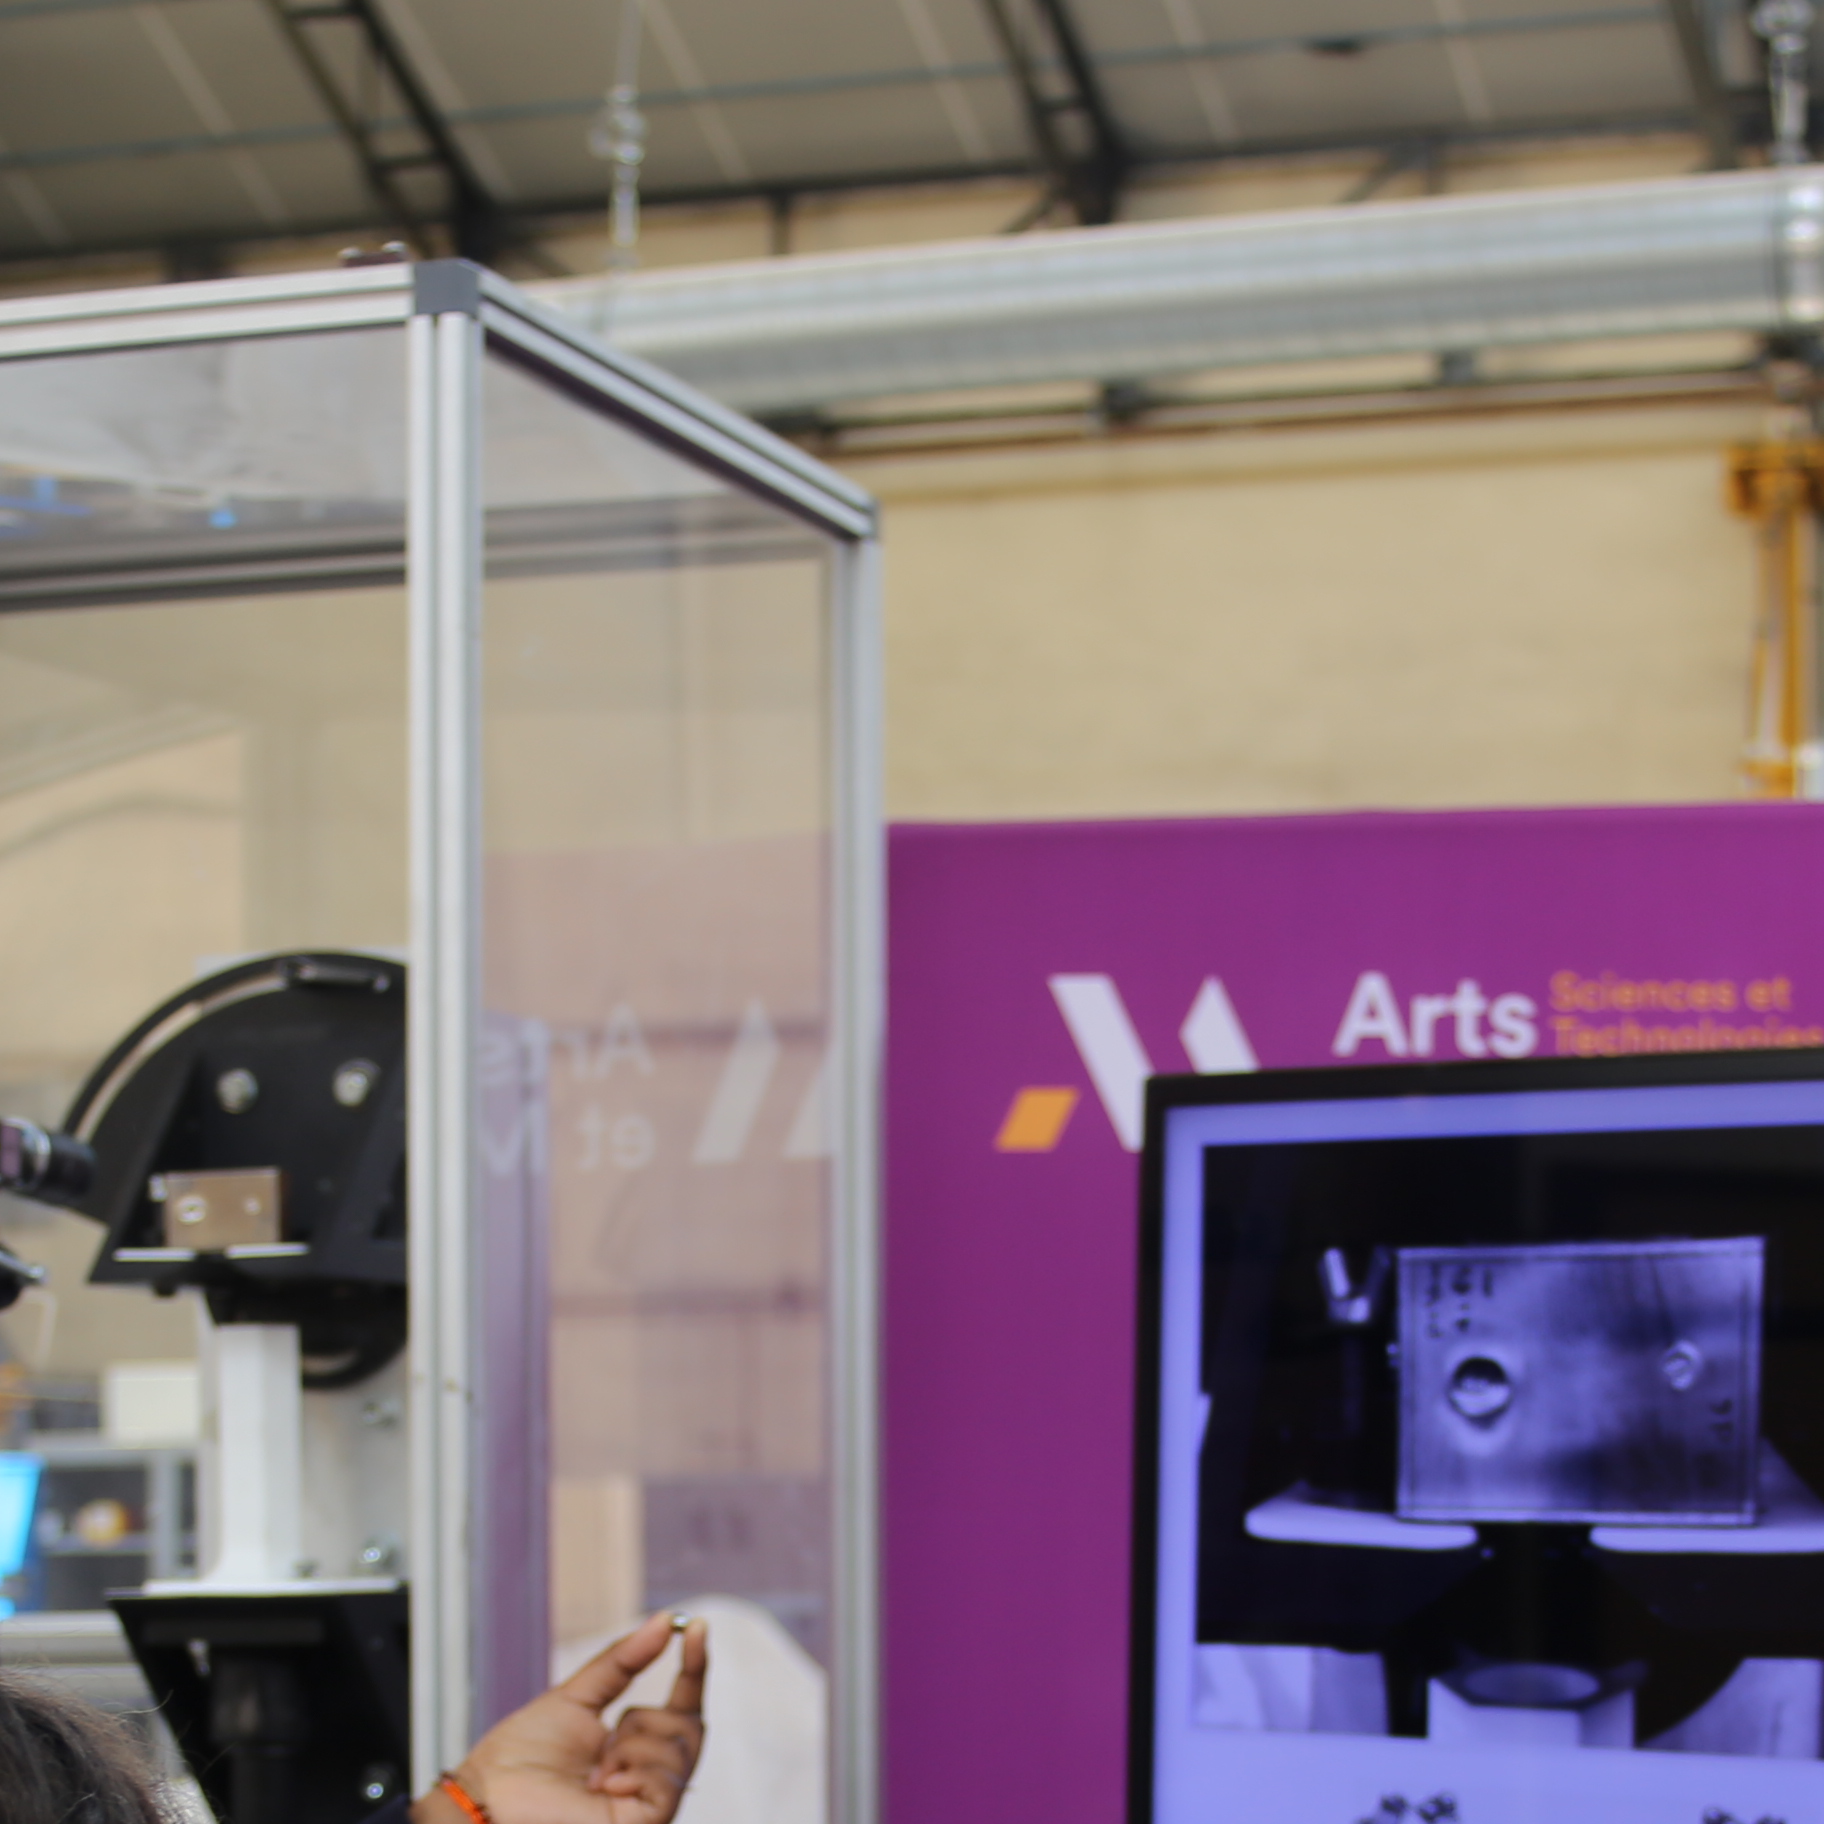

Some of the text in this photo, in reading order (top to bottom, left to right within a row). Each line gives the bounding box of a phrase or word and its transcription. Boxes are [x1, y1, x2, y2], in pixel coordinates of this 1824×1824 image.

[1331, 969, 1540, 1059] Arts
[1549, 968, 1792, 1013] Sciences et
